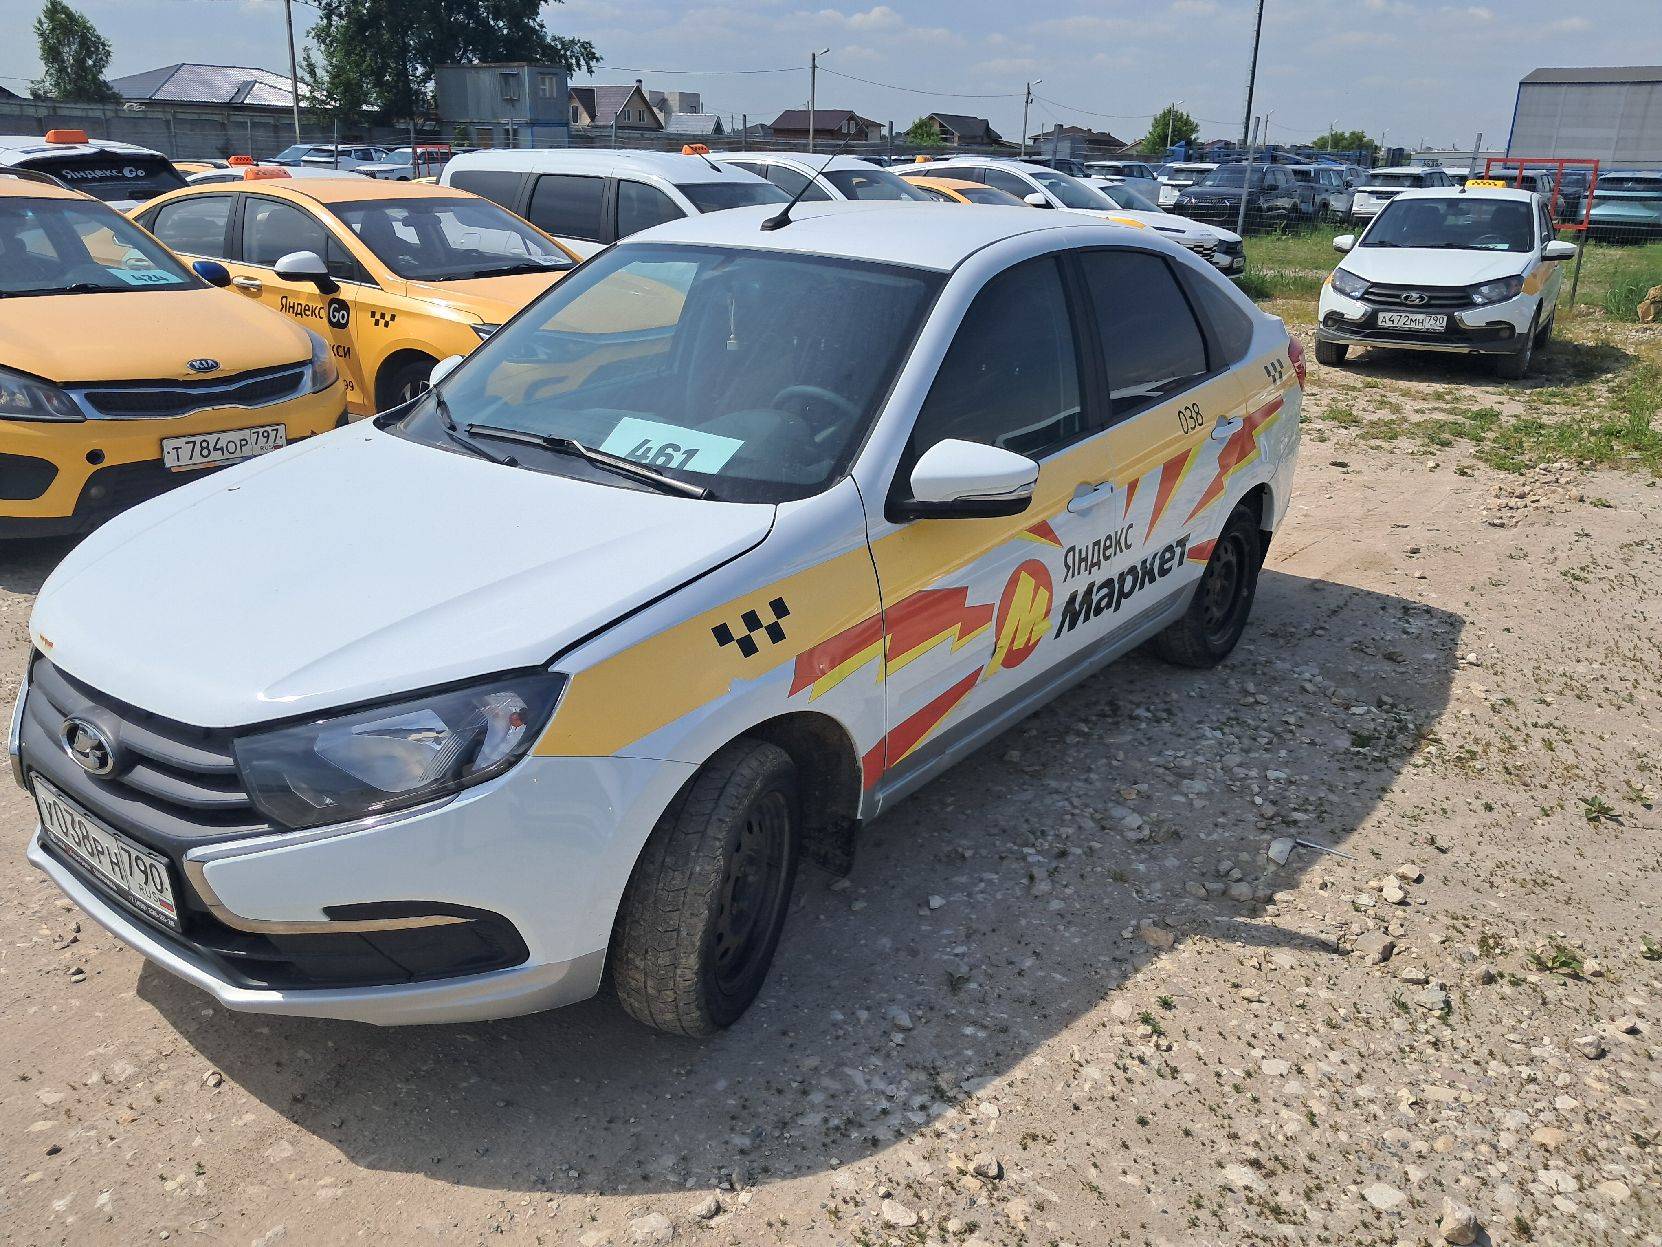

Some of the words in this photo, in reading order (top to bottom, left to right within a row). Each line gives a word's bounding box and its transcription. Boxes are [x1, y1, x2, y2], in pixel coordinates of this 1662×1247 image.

[62, 169, 121, 179] Яндекс
[122, 166, 146, 178] Go
[280, 295, 325, 320] Яндекс
[329, 303, 348, 325] Go
[1380, 314, 1425, 327] А472МН
[1426, 315, 1445, 325] 790
[191, 359, 218, 369] KIA
[1177, 402, 1204, 435] 038
[171, 437, 249, 463] Т784ОР
[252, 427, 279, 446] 797
[624, 438, 701, 470] 461
[1062, 523, 1135, 583] Яндекс
[1053, 532, 1192, 640] Маркет
[121, 844, 165, 895] 790
[138, 882, 159, 903] RUS
